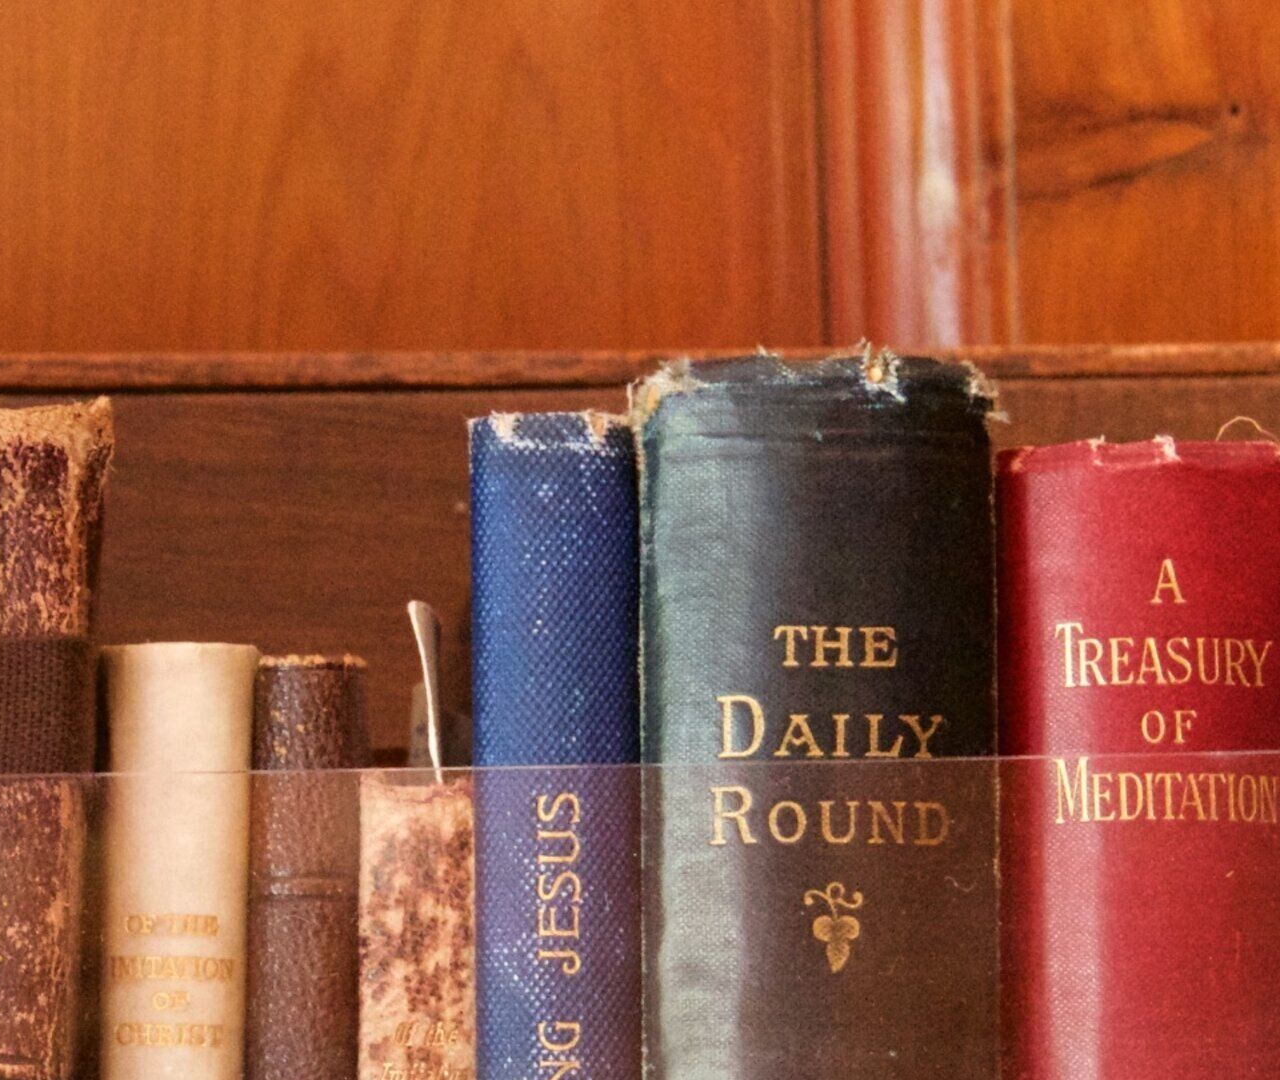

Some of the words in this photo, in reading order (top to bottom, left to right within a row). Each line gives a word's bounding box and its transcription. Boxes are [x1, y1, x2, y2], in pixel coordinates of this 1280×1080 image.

[1150, 558, 1186, 605] A
[773, 624, 899, 668] THE
[1055, 622, 1273, 688] TREASURY
[716, 694, 944, 759] DAILY
[1141, 710, 1198, 744] OF
[709, 786, 951, 847] ROUND
[1055, 756, 1280, 824] MEDITATION
[536, 792, 582, 976] JESUS
[115, 1022, 224, 1047] CHRIST
